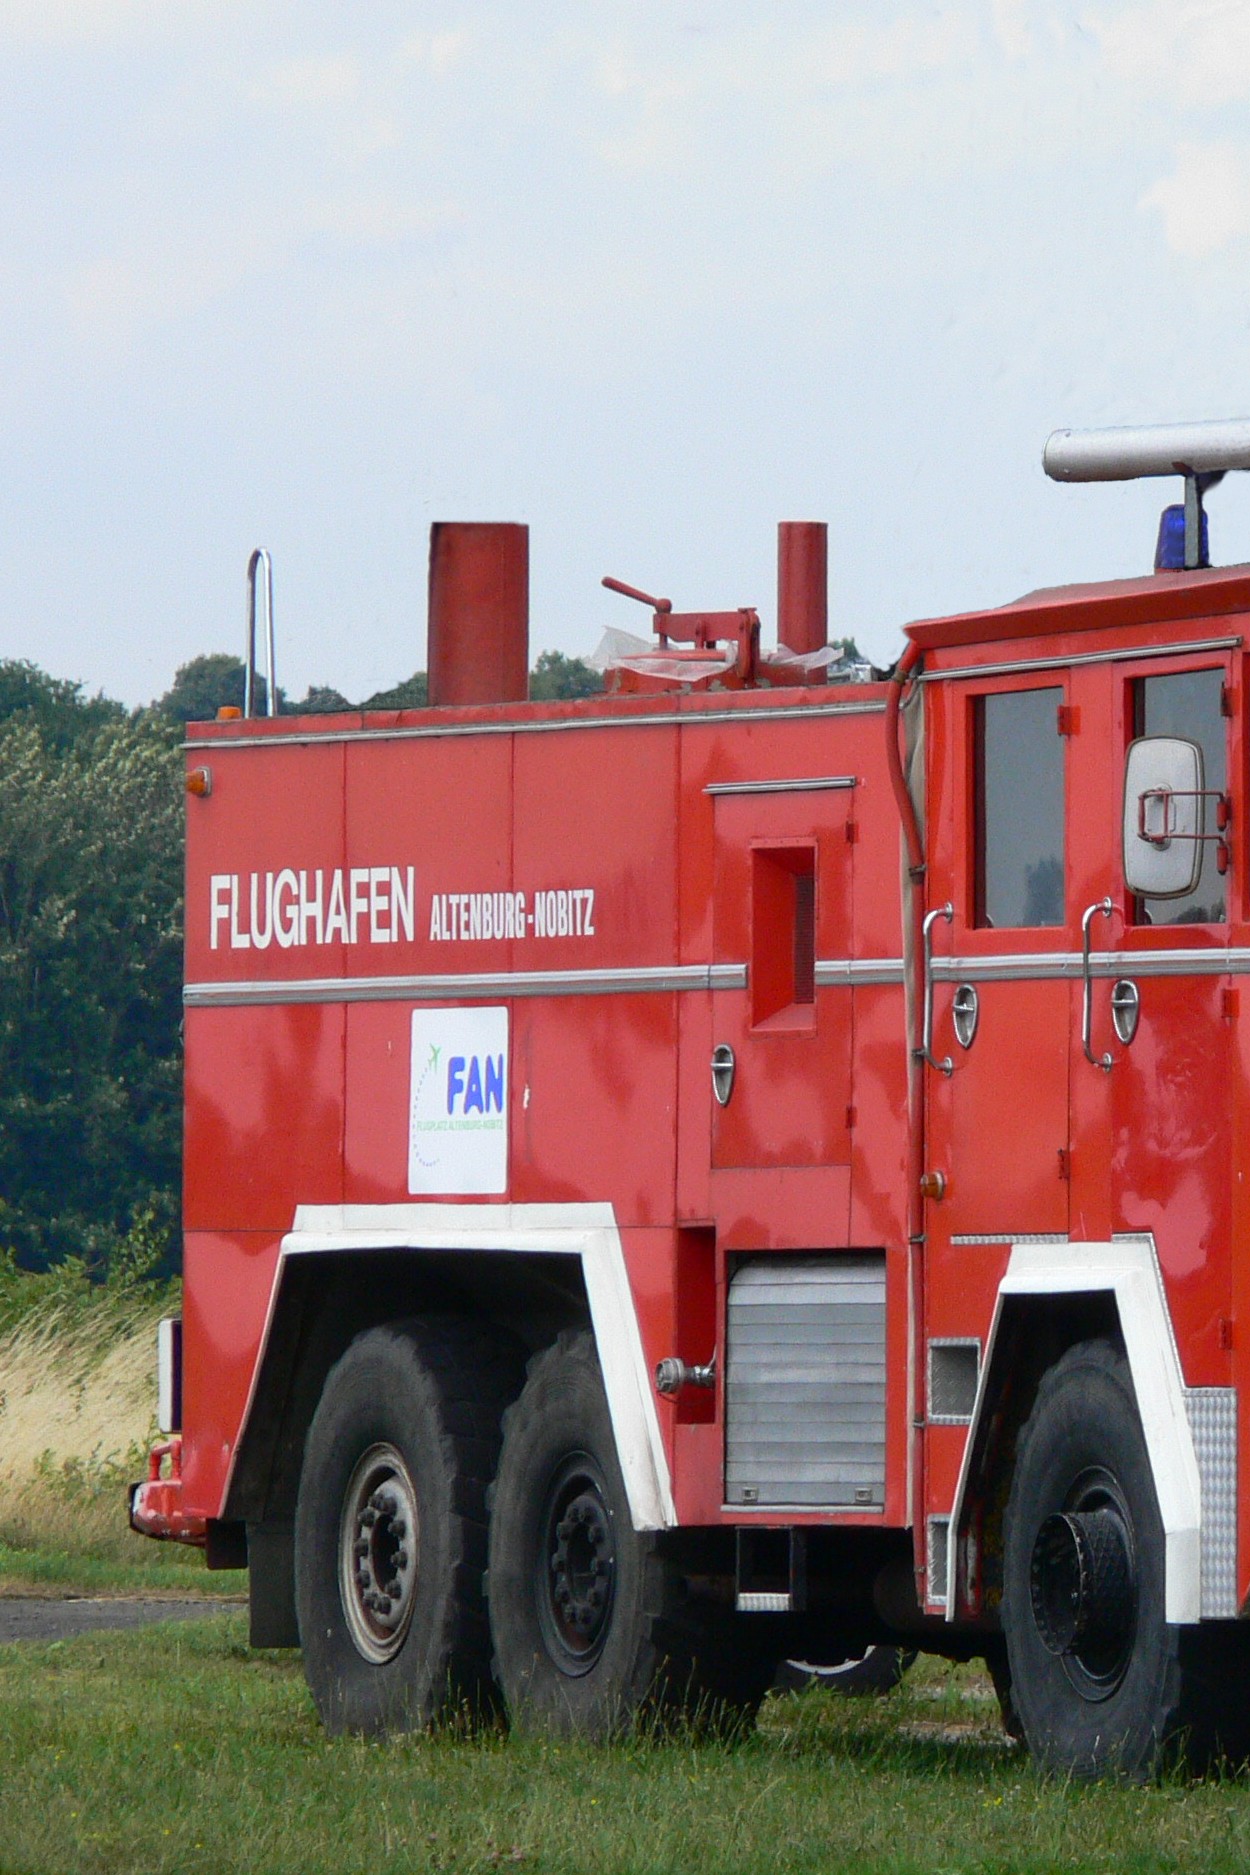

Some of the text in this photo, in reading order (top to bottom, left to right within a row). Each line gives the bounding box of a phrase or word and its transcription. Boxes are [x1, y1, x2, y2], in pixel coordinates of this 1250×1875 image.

[210, 866, 595, 949] FLUGHAFEN ALTENBURG-NOBITZ
[447, 1053, 504, 1115] FAN
